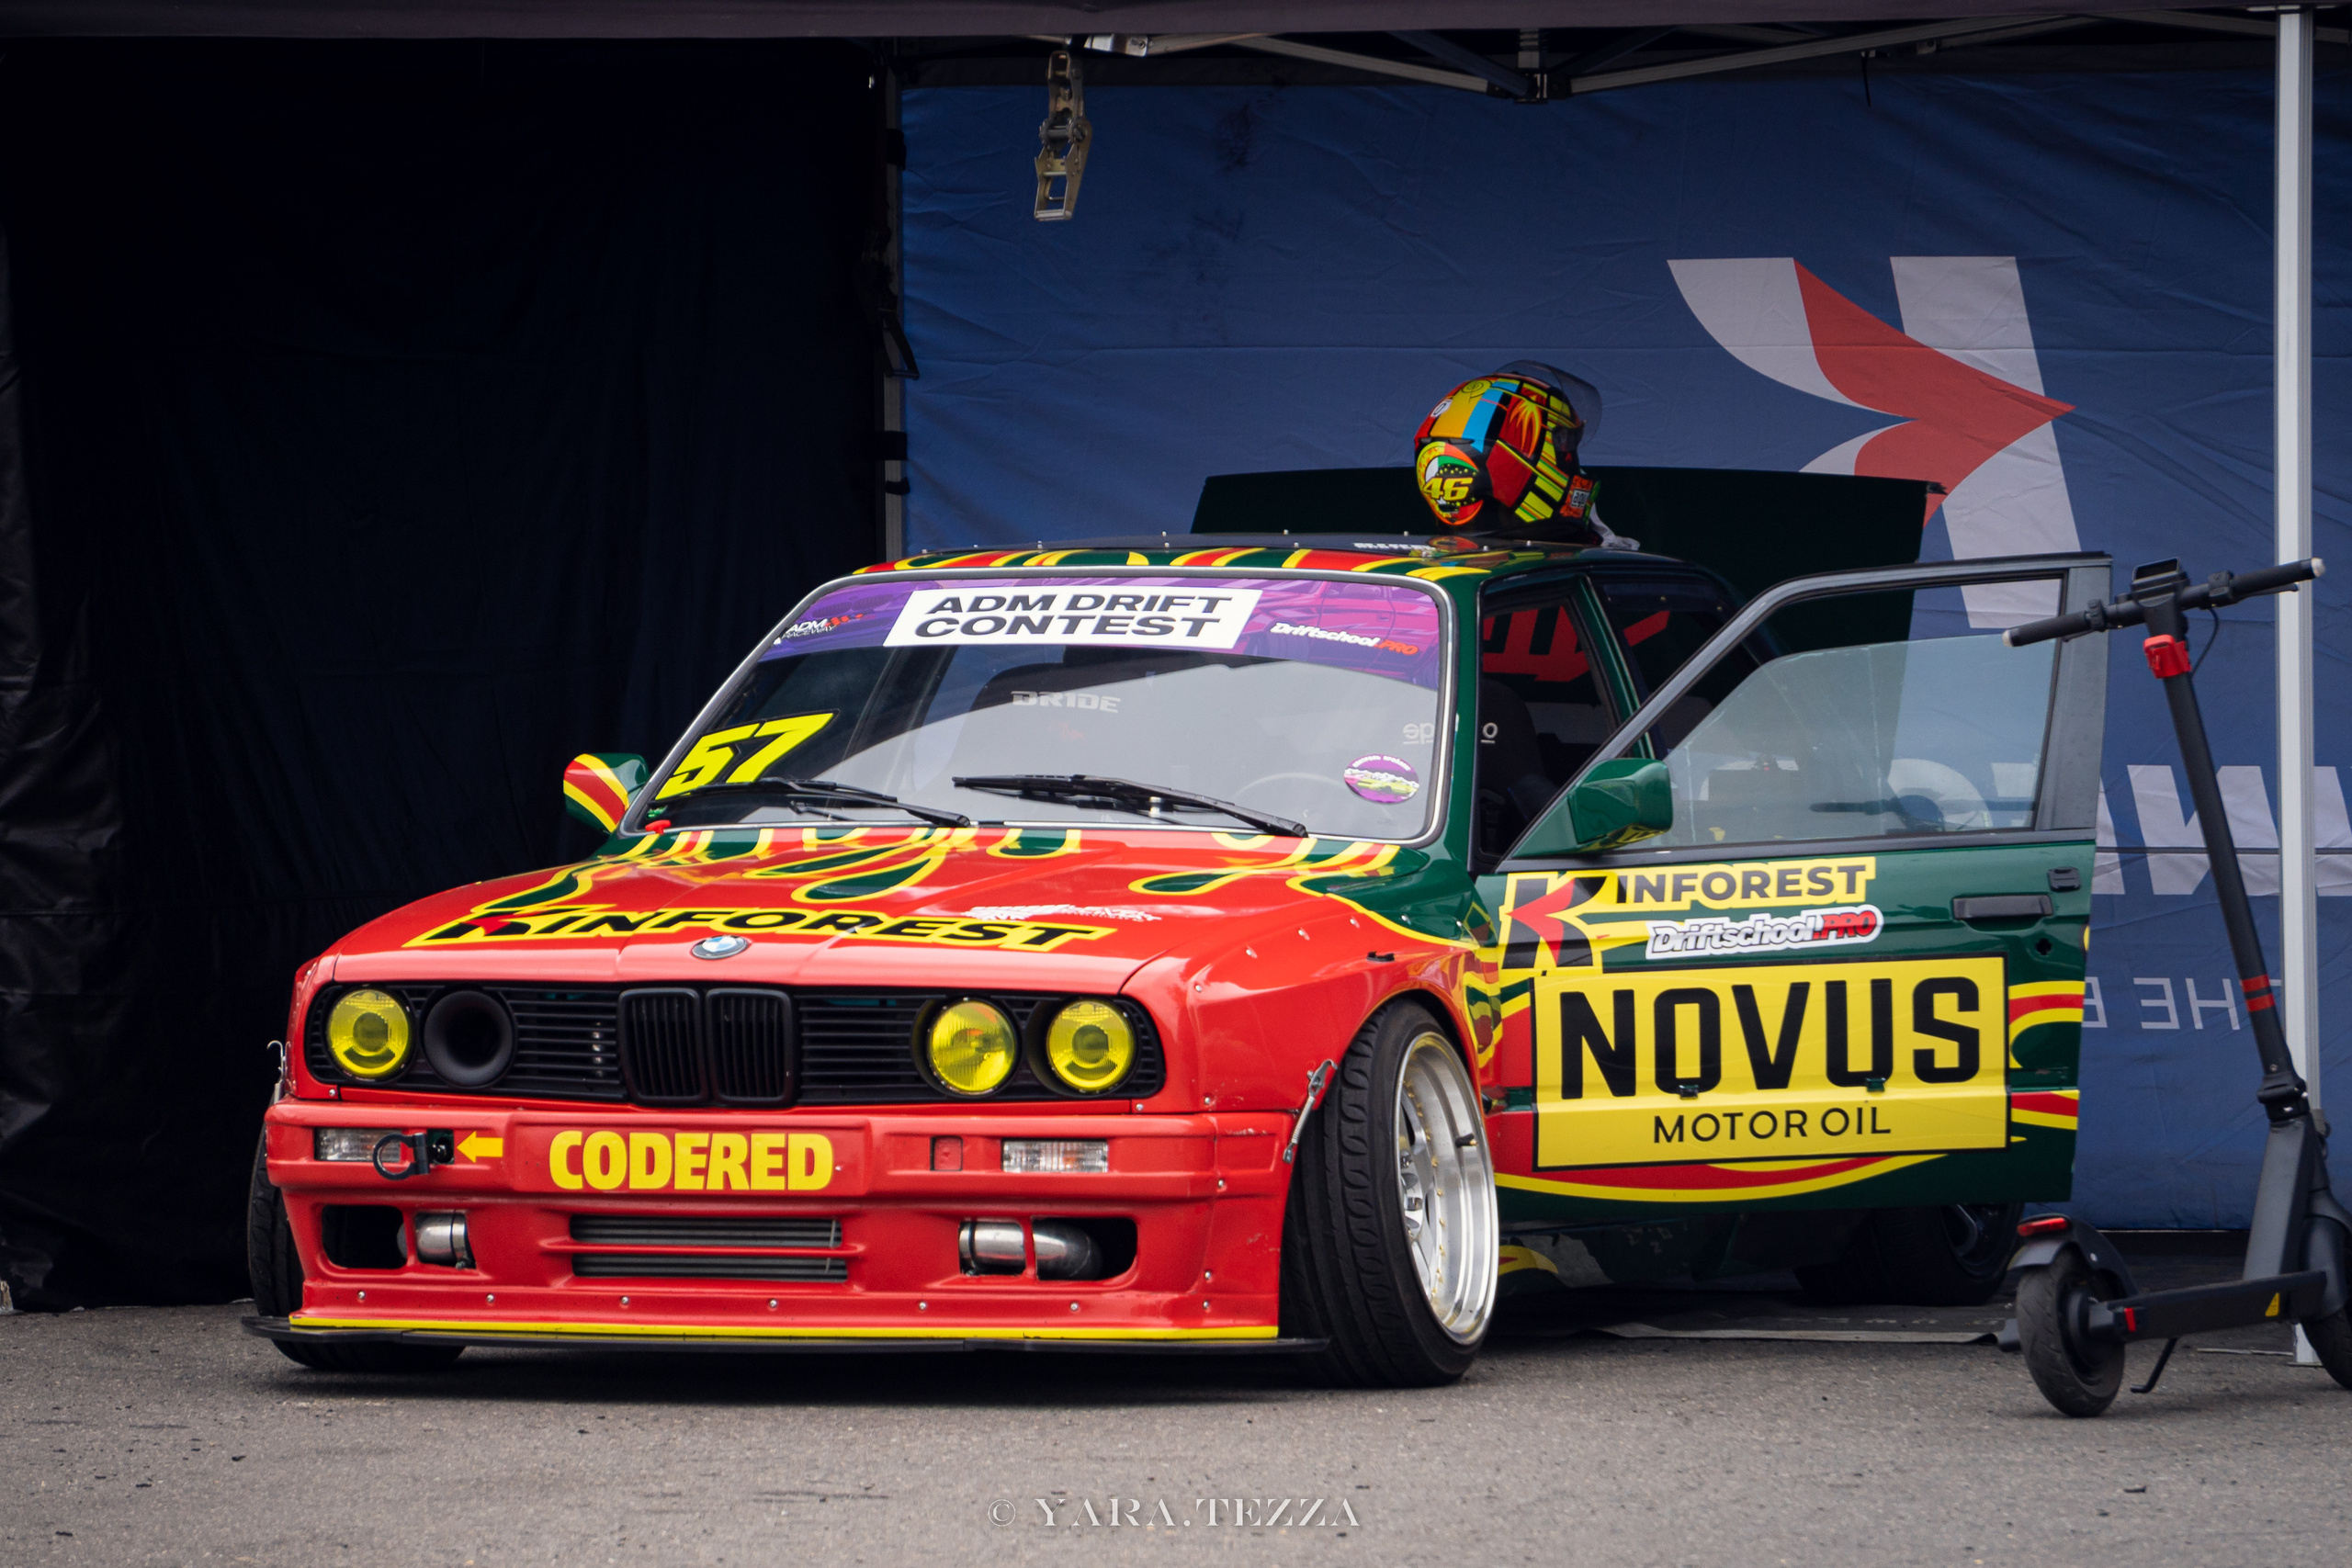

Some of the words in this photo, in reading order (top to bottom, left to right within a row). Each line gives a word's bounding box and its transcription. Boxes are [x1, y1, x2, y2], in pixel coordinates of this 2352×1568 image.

[1422, 477, 1473, 501] 46
[925, 594, 1057, 615] ADM
[1064, 595, 1233, 614] DRIFT
[786, 618, 828, 634] ADM
[915, 615, 1221, 637] CONTEST
[1270, 622, 1419, 656] Driftschool.PRO
[1011, 691, 1121, 713] BRIDE
[655, 713, 833, 800] 57
[425, 908, 1096, 951] KINFOREST
[1501, 864, 1866, 969] KINFOREST
[1653, 909, 1877, 953] Driftschool.PRO
[1560, 978, 1980, 1100] NOVUS
[1654, 1110, 1808, 1143] MOTOR
[1820, 1106, 1892, 1136] OIL
[549, 1131, 833, 1190] CODERED
